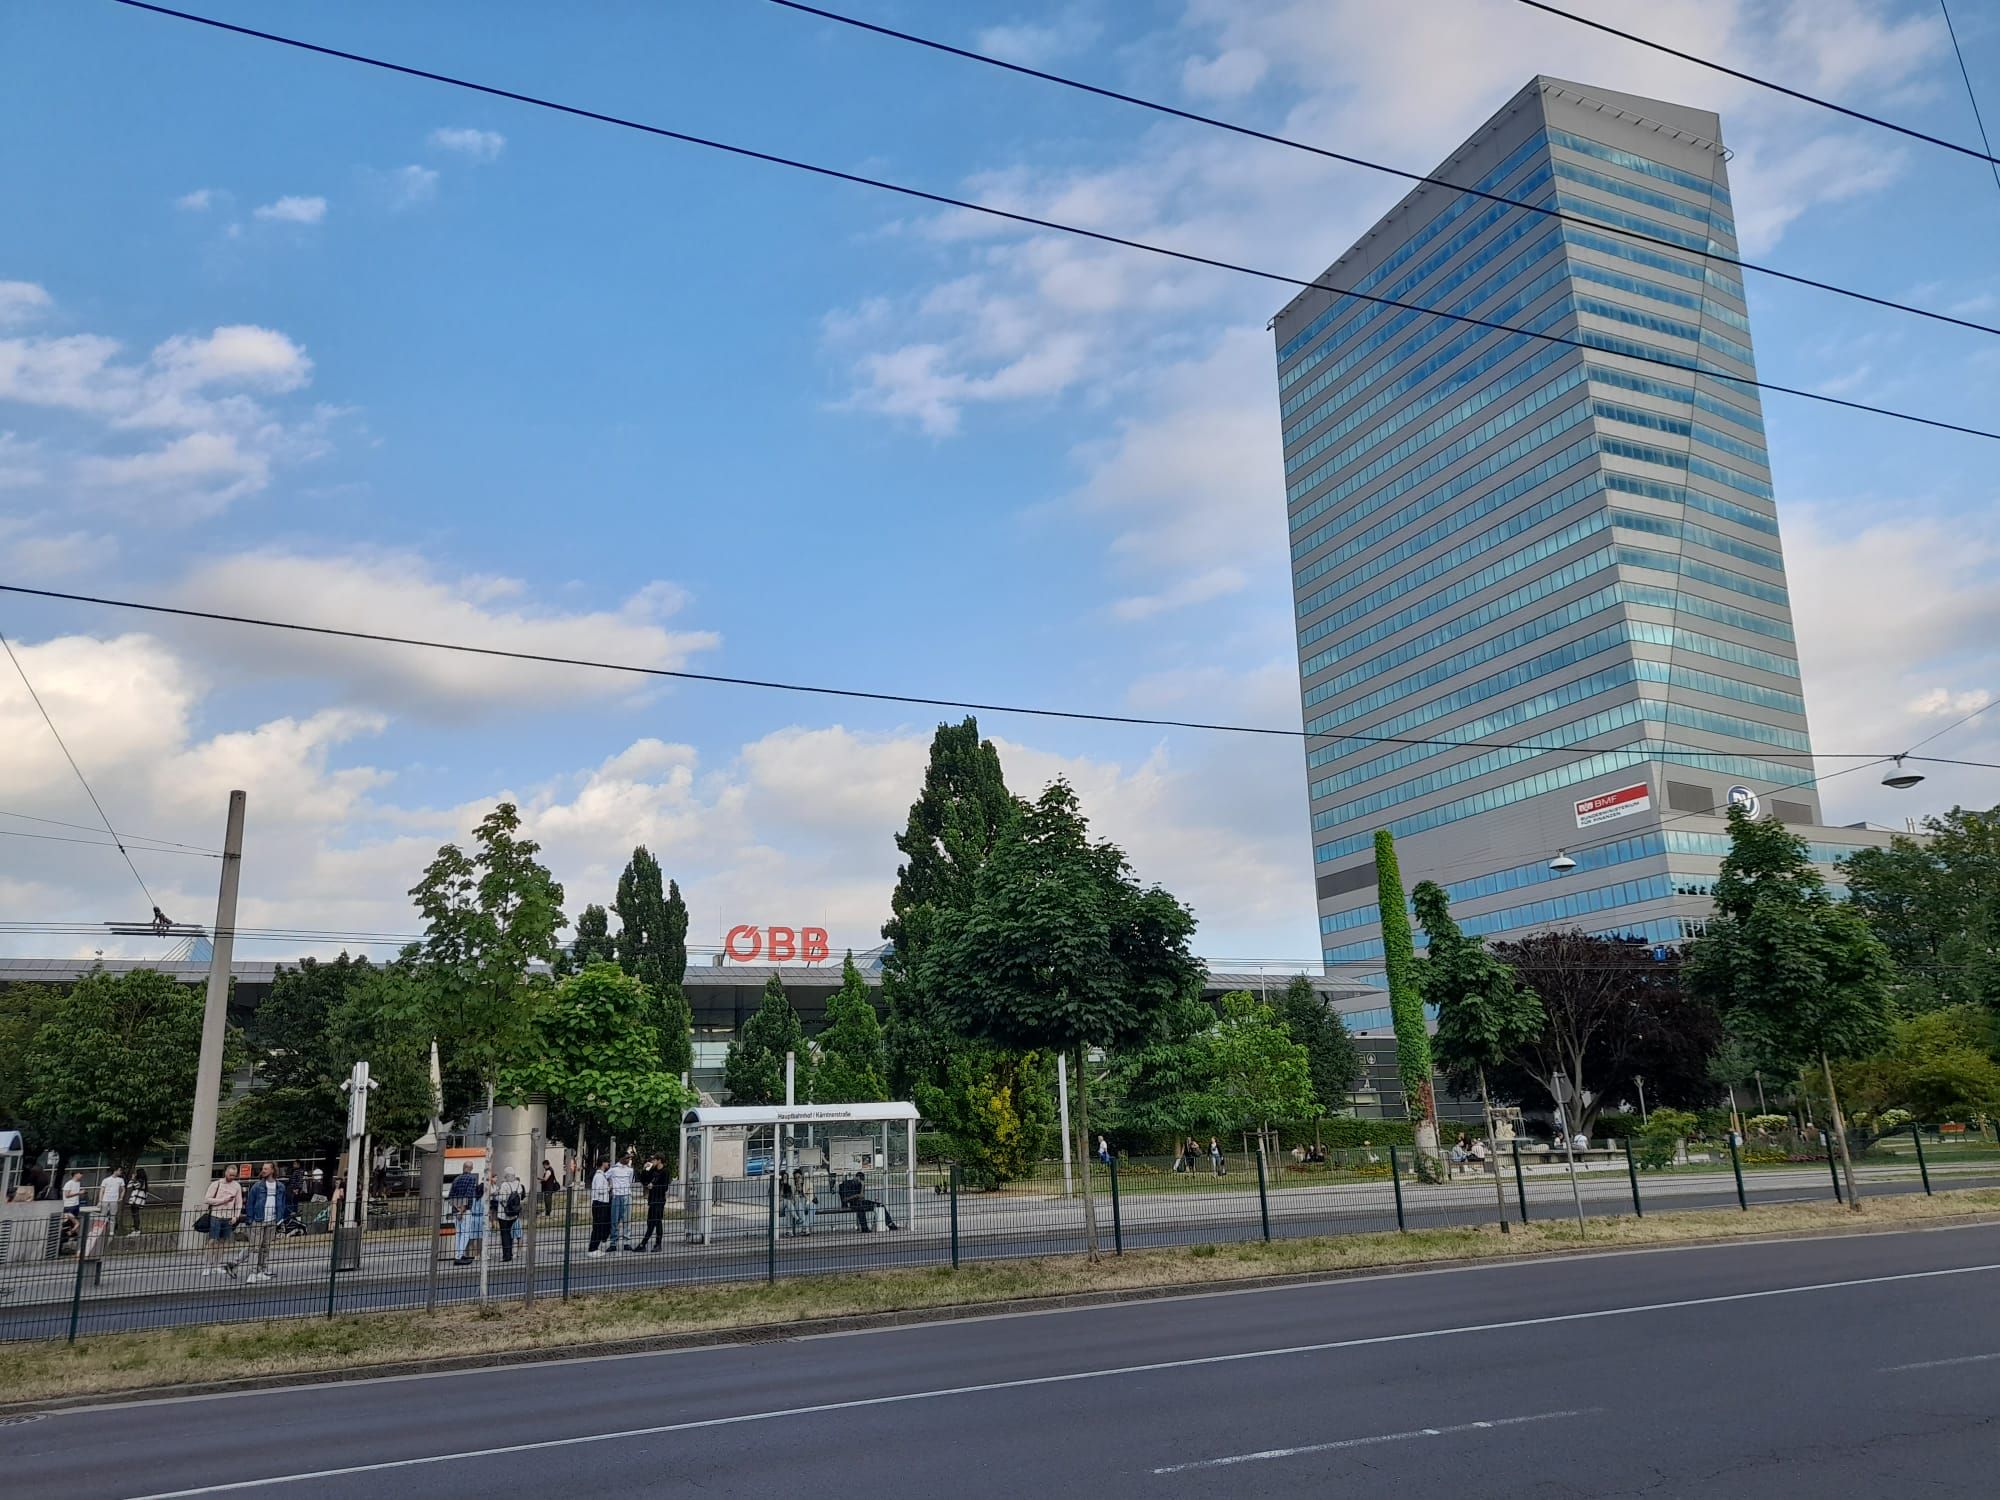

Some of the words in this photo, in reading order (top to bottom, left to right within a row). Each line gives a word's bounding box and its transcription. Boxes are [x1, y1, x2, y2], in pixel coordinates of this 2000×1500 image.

[1594, 795, 1617, 808] BMF
[1593, 811, 1621, 822] FINANZEN
[726, 925, 829, 962] ÖBB
[778, 1112, 812, 1120] Hauptbahnhof
